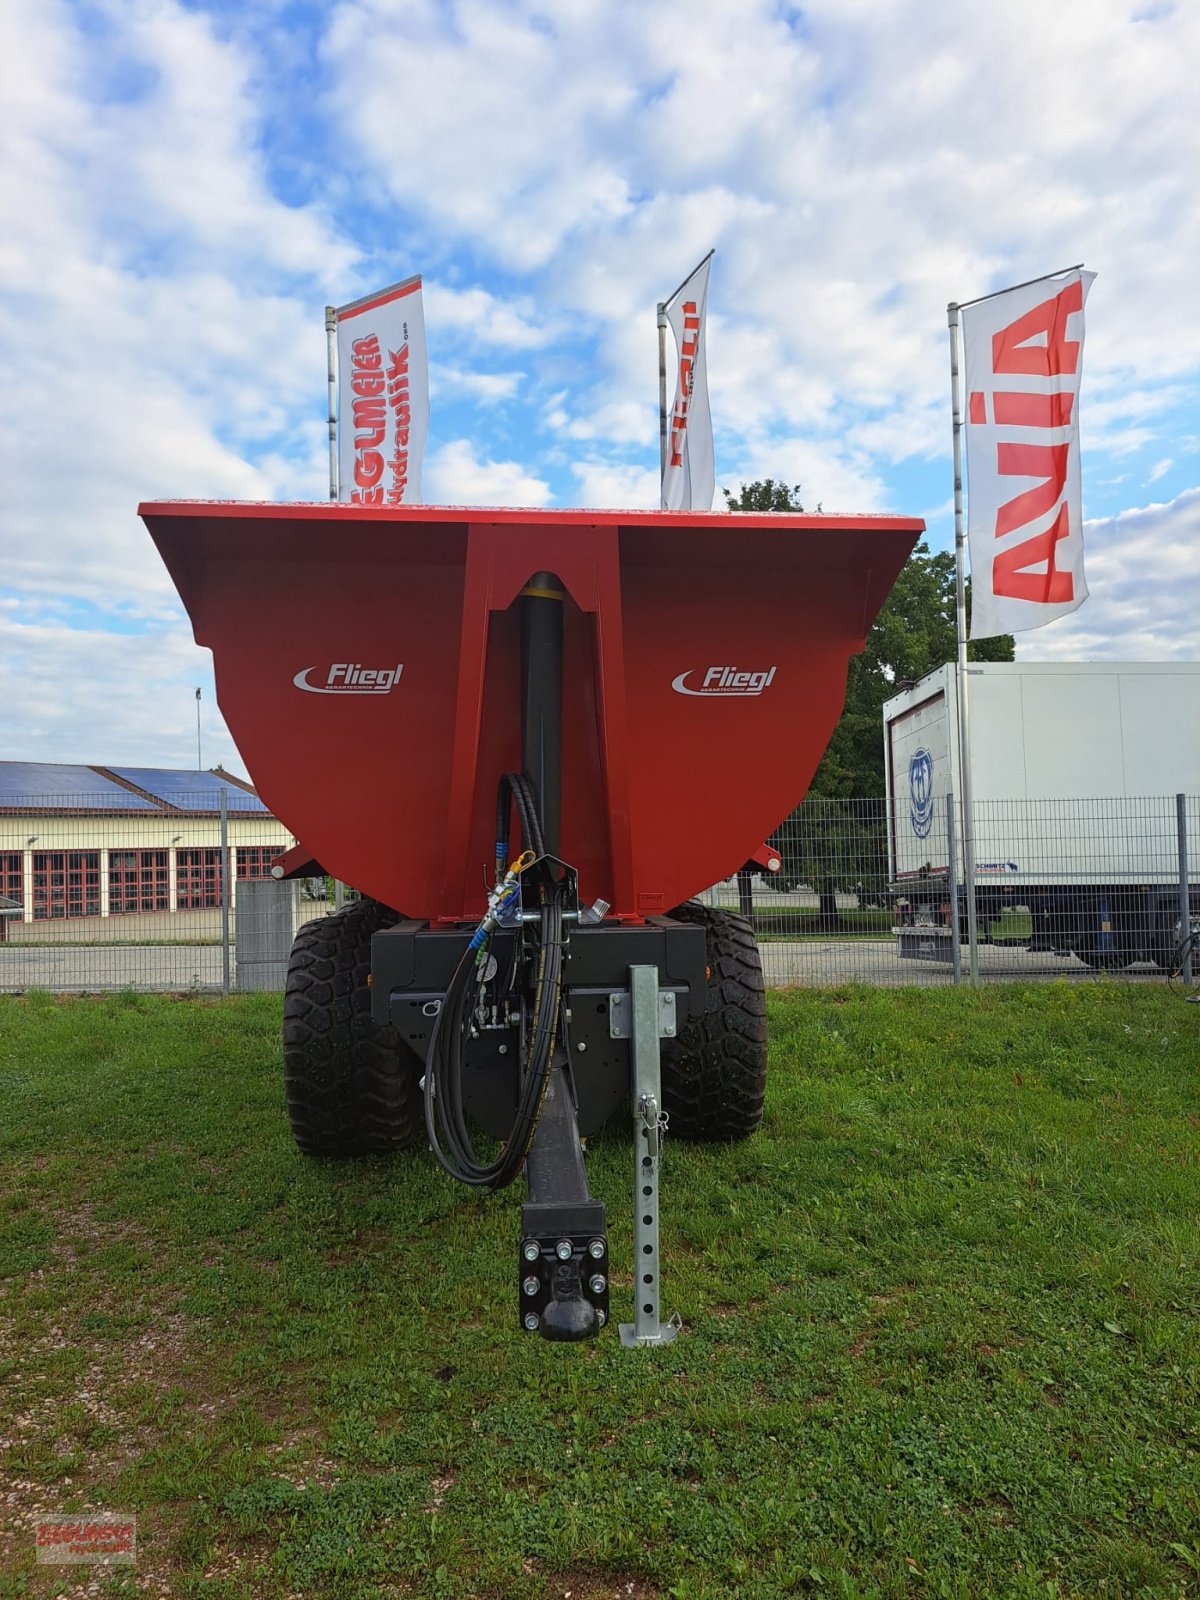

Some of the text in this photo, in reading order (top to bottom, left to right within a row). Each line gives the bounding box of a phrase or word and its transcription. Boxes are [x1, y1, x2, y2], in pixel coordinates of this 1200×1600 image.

[386, 342, 411, 505] Hydraulik
[327, 663, 404, 690] Fliegl
[703, 666, 777, 692] Fliegl
